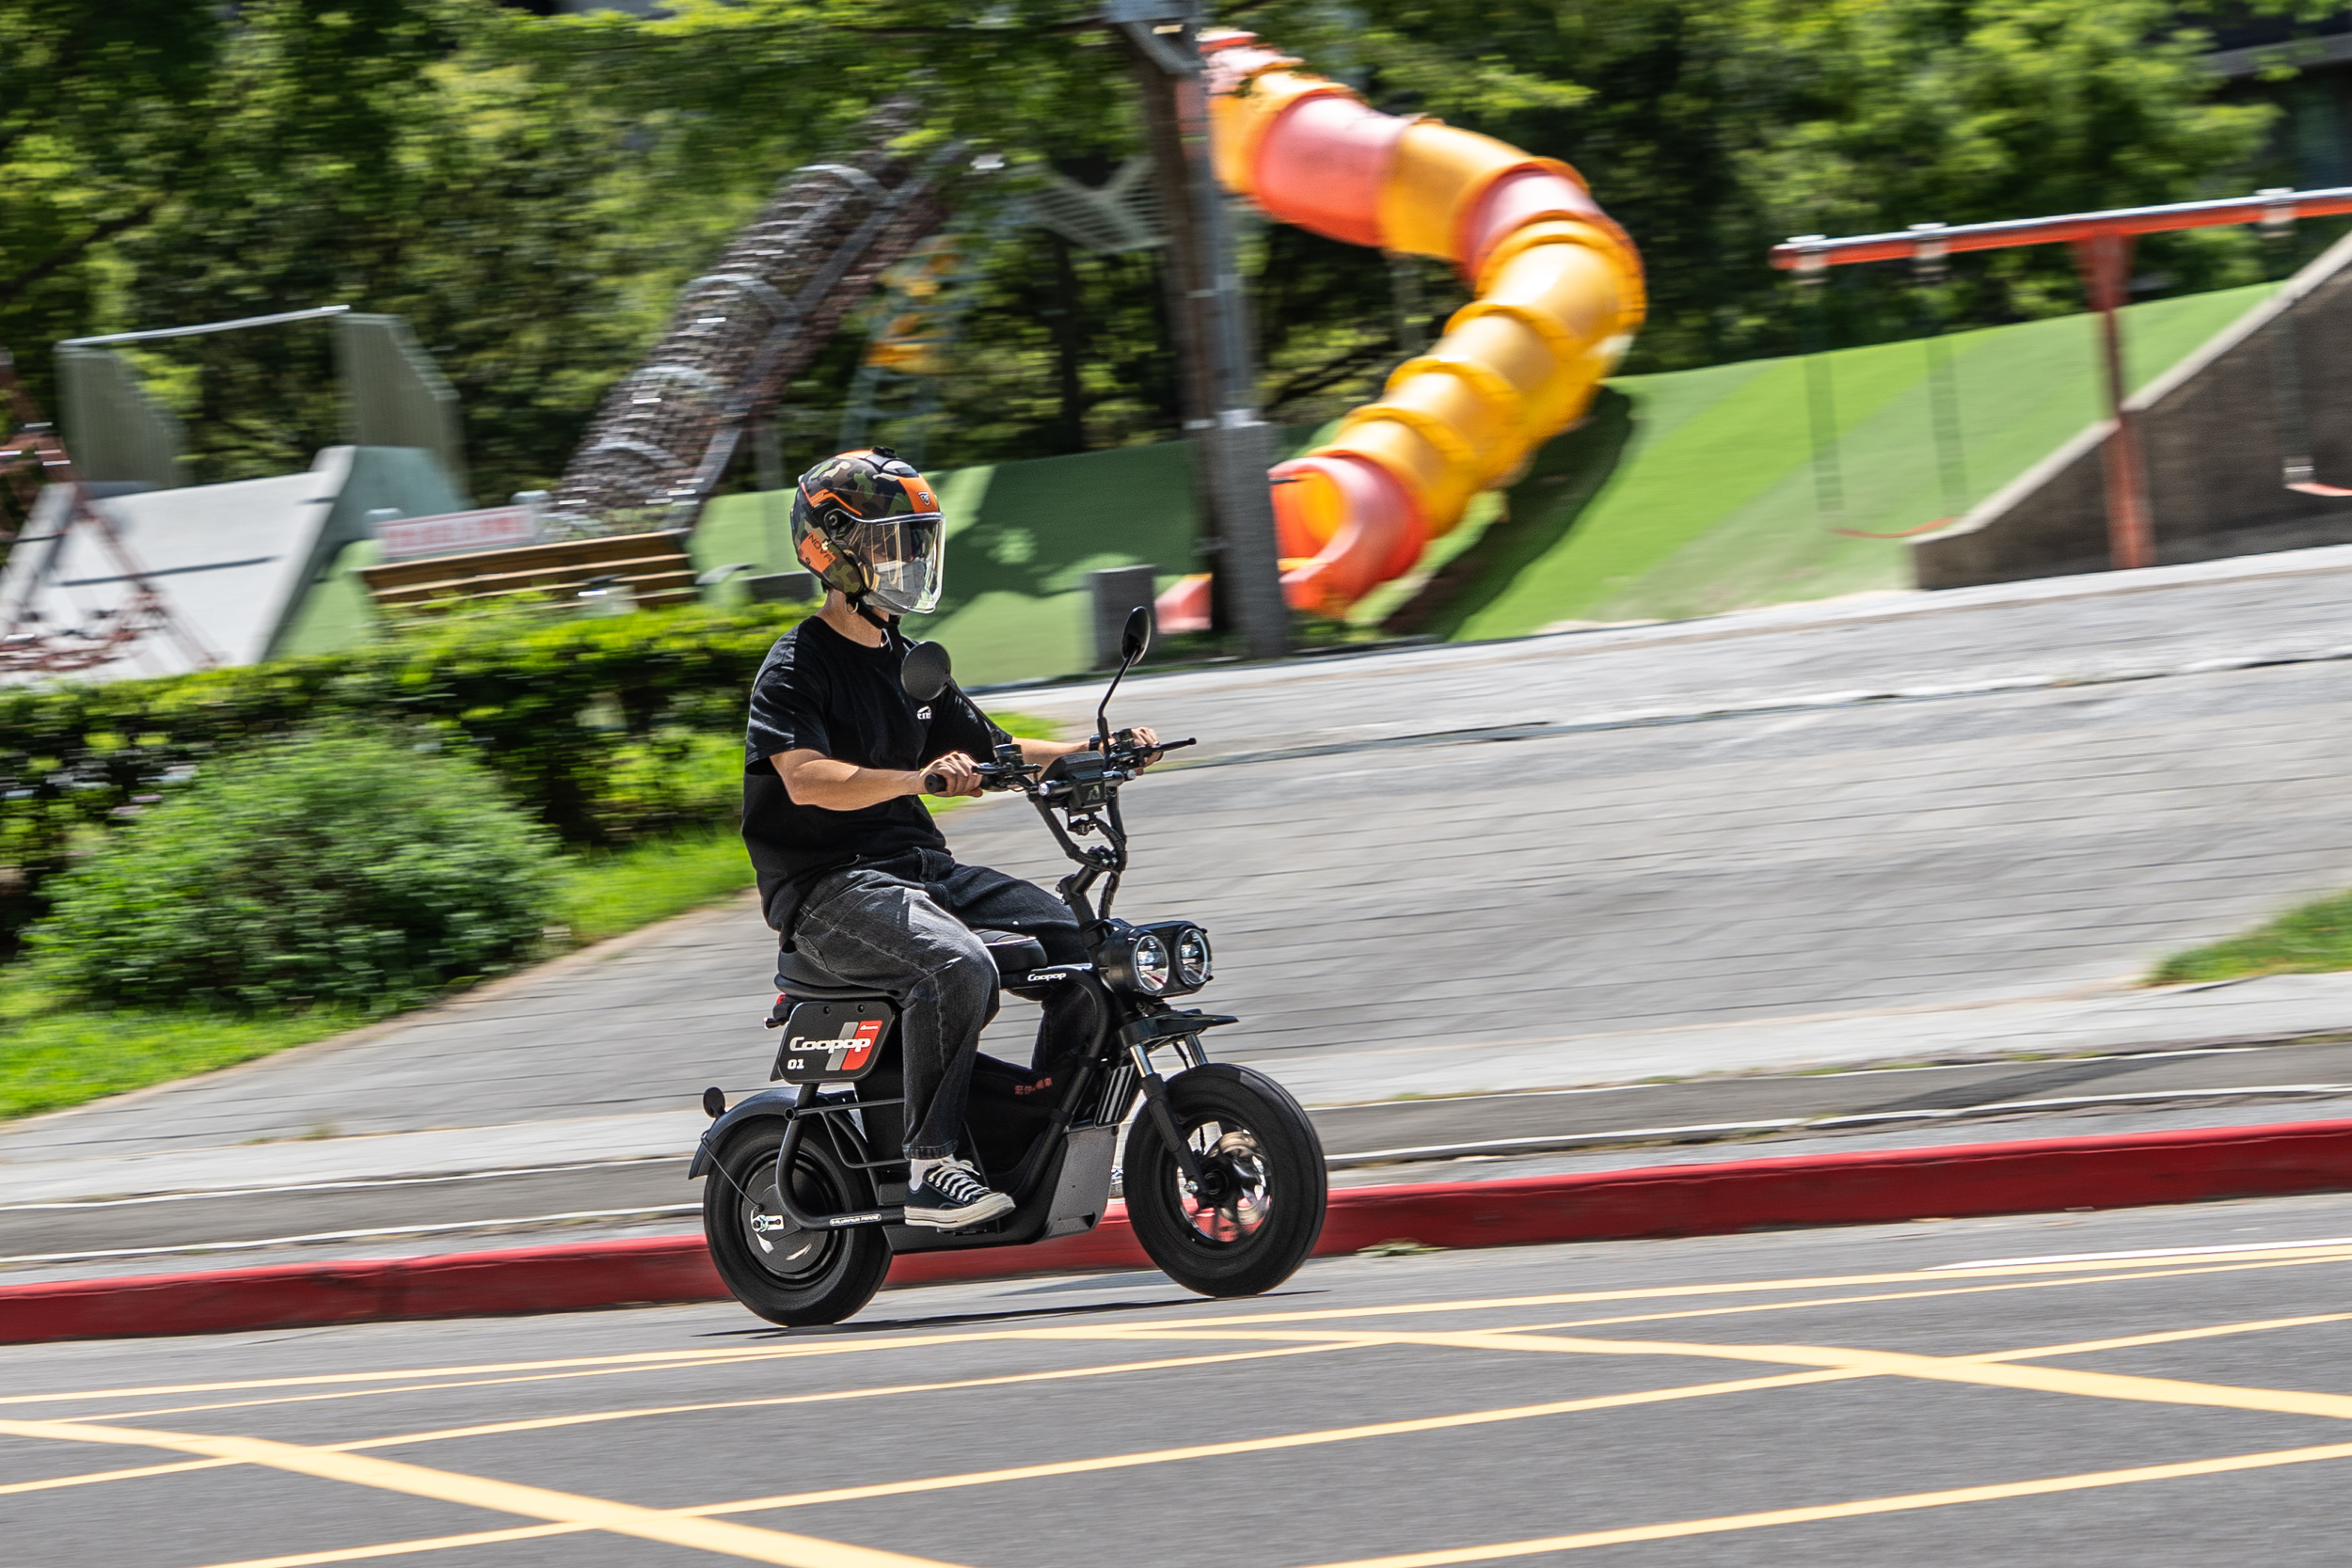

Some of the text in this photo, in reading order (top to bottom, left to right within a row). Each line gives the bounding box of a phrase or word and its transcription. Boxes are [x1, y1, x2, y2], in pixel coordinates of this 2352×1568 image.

[1027, 973, 1067, 982] Coopop
[789, 1036, 871, 1053] Coopop
[787, 1058, 804, 1070] 01
